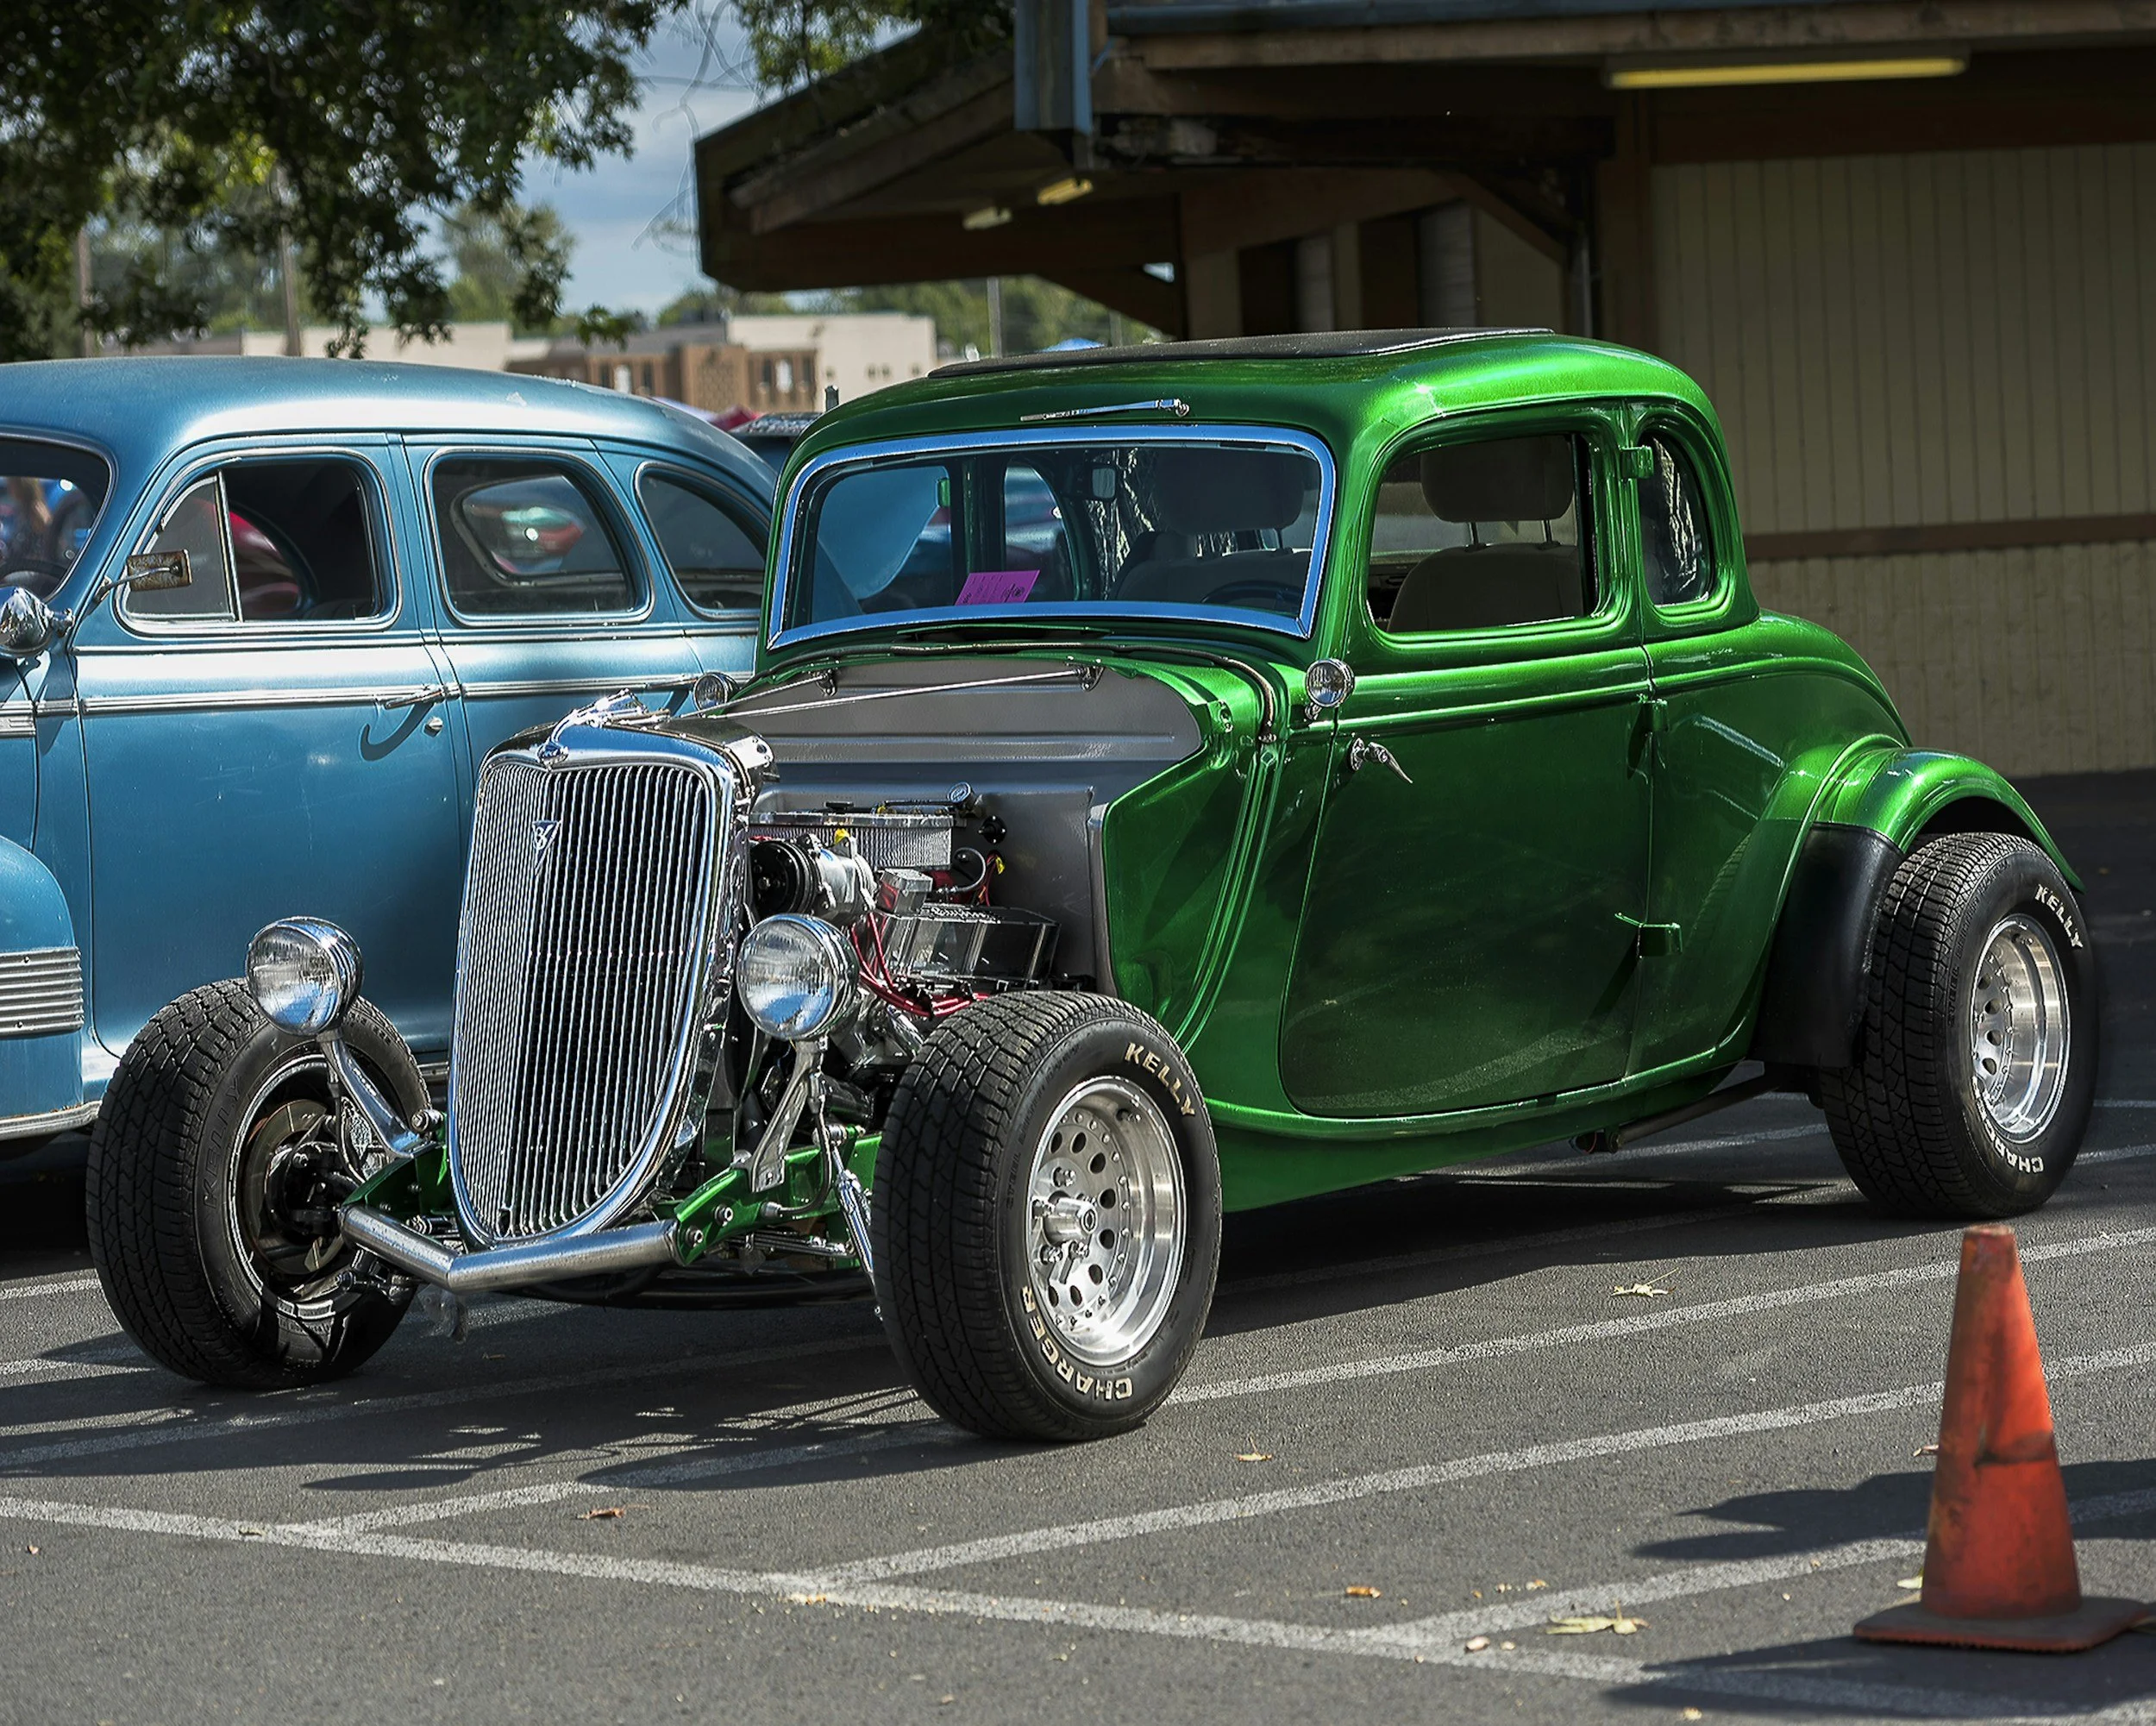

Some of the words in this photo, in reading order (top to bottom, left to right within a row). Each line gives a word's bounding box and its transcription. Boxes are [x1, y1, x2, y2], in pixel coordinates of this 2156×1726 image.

[2035, 883, 2084, 948] KELLY
[1124, 1041, 1196, 1116] KELLY
[203, 1074, 241, 1209] KELLY
[1021, 1285, 1133, 1400] CHARGER
